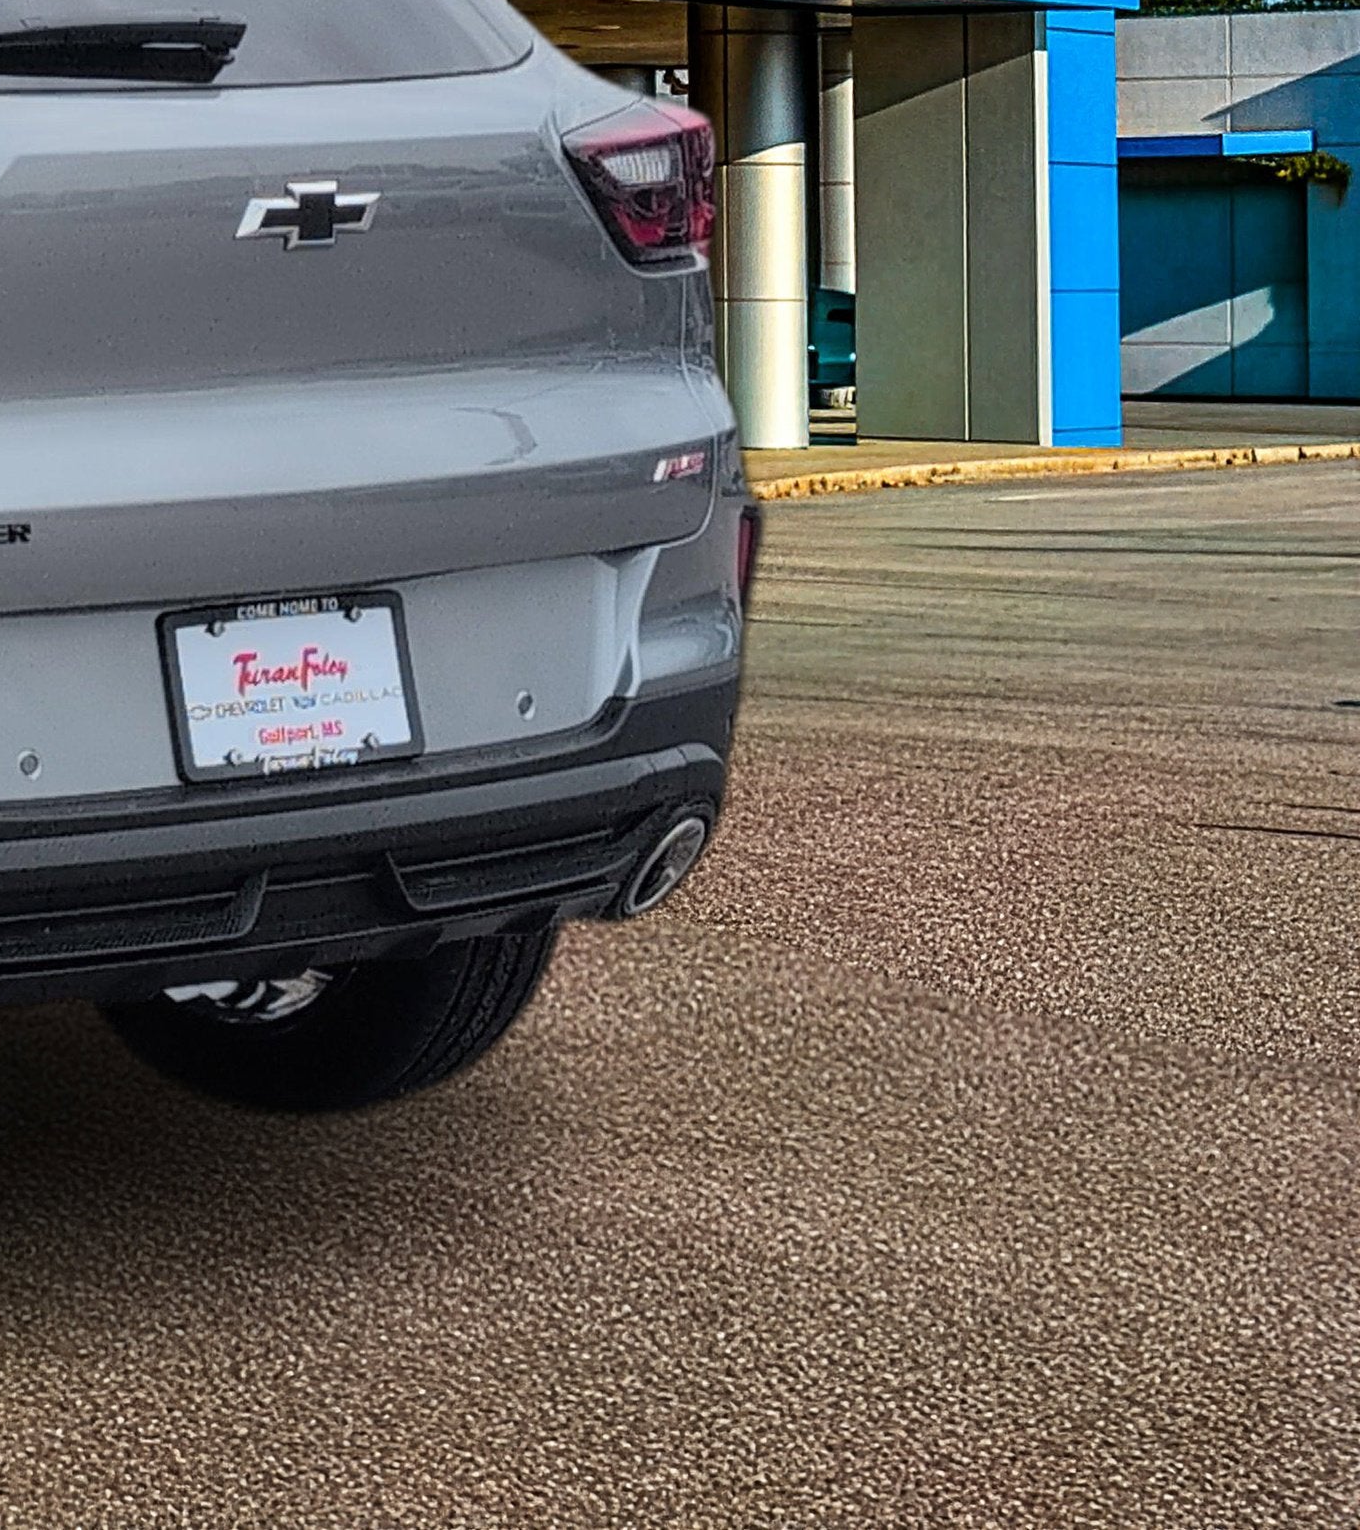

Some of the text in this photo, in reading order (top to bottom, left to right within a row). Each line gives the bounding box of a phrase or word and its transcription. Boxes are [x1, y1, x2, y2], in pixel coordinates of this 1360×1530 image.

[237, 601, 278, 619] COME
[320, 596, 339, 611] TO
[215, 685, 403, 719] CHEVROLET CADILLAC
[321, 720, 343, 737] MS
